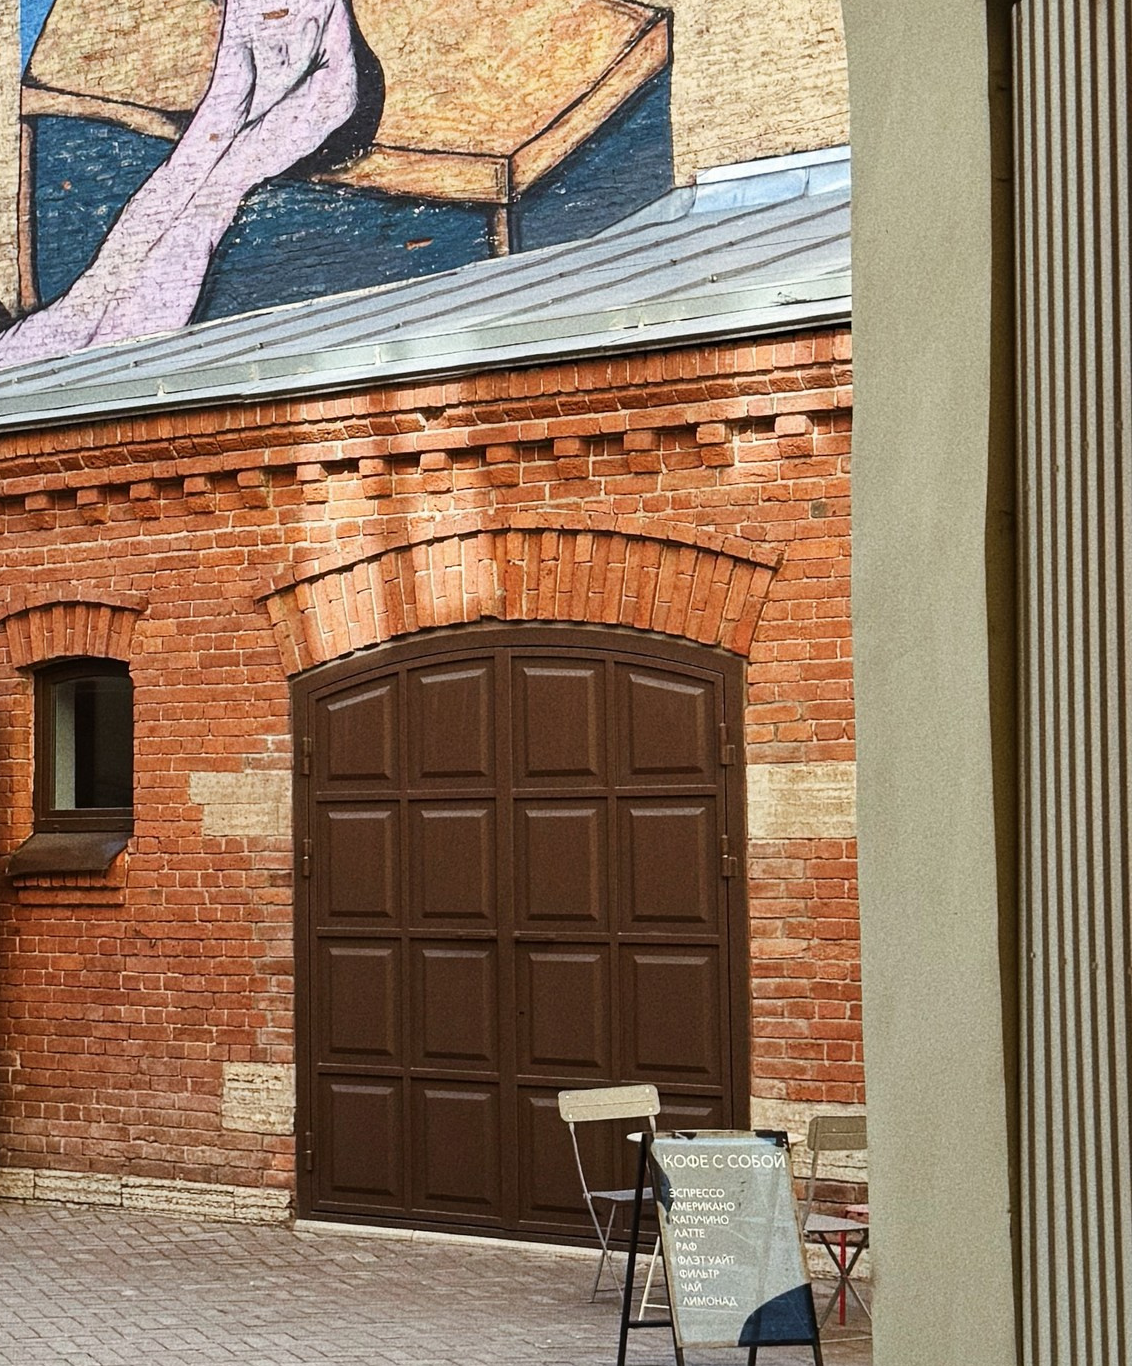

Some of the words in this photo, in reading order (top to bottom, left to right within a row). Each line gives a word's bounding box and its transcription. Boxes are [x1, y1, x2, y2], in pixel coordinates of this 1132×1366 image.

[663, 1154, 709, 1168] КОФЕ
[713, 1154, 724, 1168] С
[727, 1153, 786, 1168] СОБОЙ
[669, 1188, 725, 1198] ЭСПРЕССО
[670, 1202, 735, 1211] АМЕРИКАНО
[672, 1215, 729, 1225] КАПУЧИНО
[674, 1229, 705, 1238] ЛАТТЕ
[676, 1242, 697, 1252] РАФ
[677, 1255, 705, 1265] ФЛЭТ
[707, 1255, 735, 1265] УАЙТ
[679, 1269, 720, 1279] ФИЛЬТР
[681, 1281, 702, 1292] ЧАЙ
[683, 1296, 739, 1307] ЛИМОНАД
